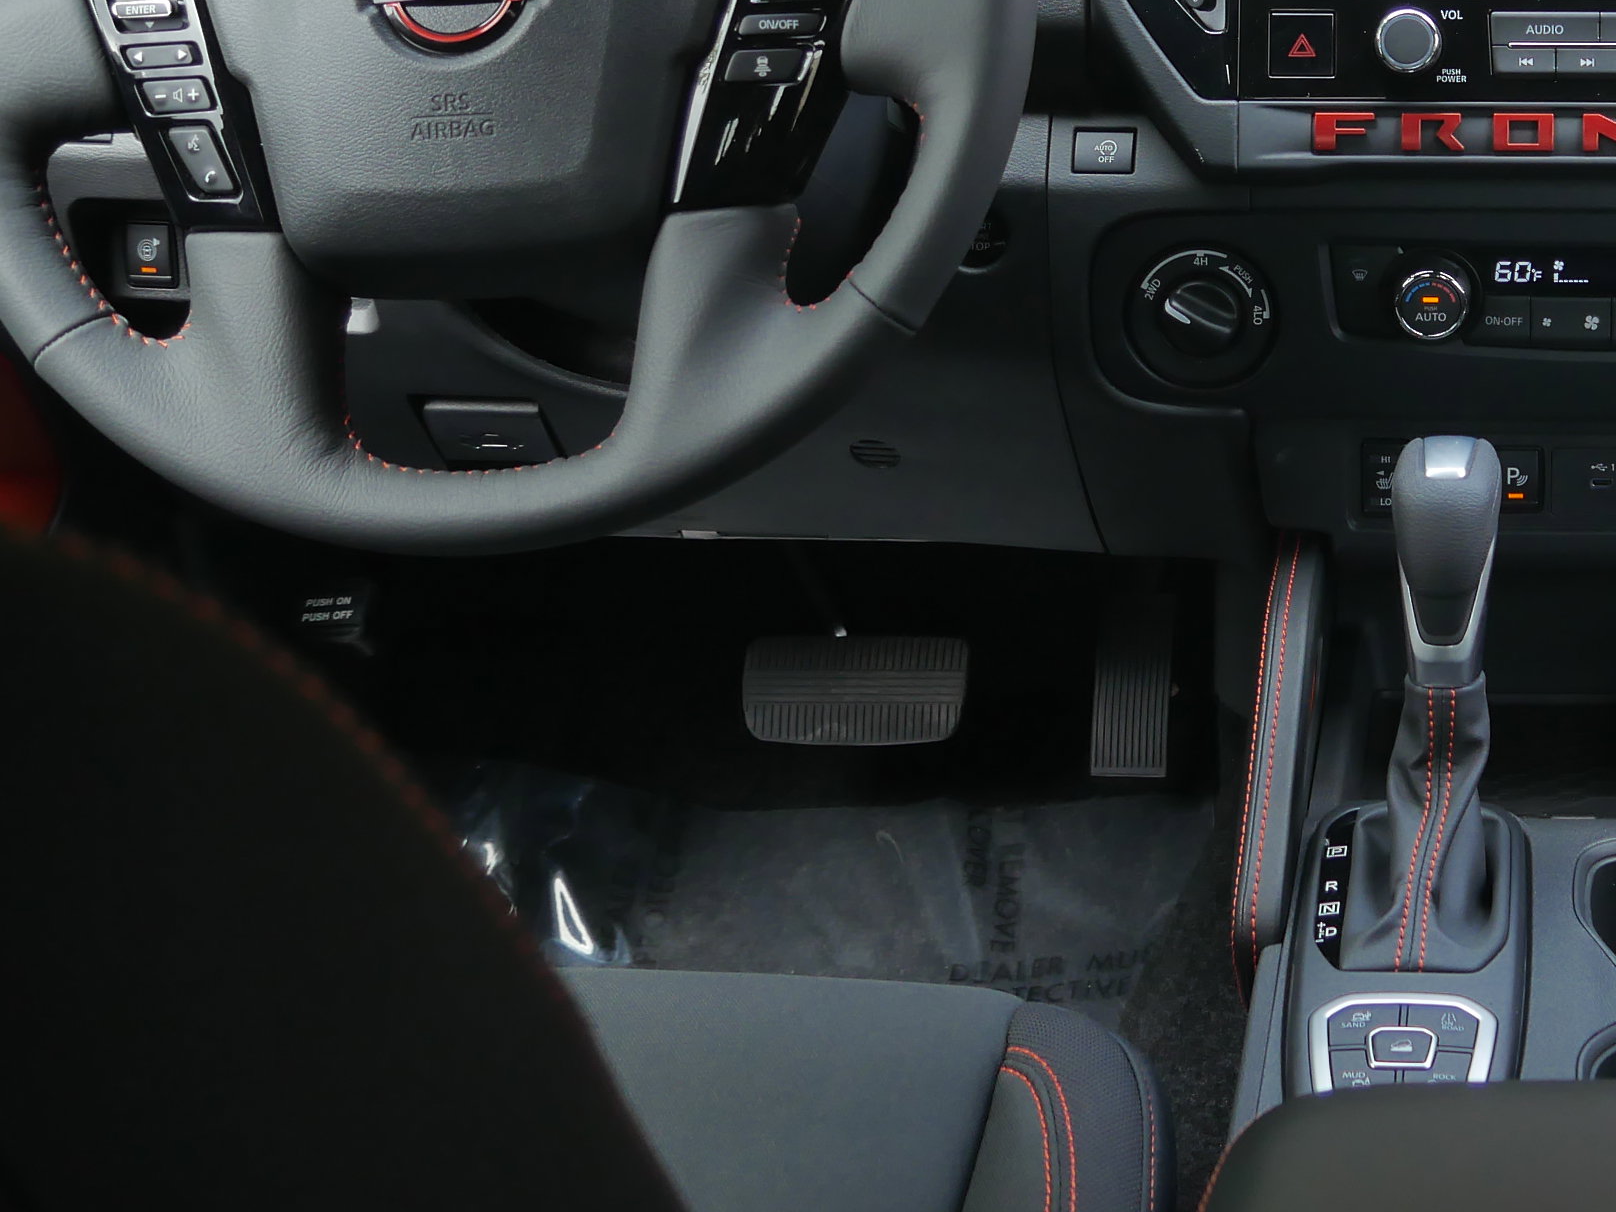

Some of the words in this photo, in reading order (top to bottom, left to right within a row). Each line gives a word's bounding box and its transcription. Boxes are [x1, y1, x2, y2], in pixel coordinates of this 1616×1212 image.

[125, 4, 156, 15] ENTER
[1441, 10, 1463, 20] VOL
[759, 20, 799, 29] ON/OFF
[1526, 24, 1564, 35] AUDIO
[1436, 75, 1467, 83] POWER
[431, 93, 470, 111] SRS
[411, 119, 495, 140] AIRBAG
[1194, 257, 1208, 266] 4H
[1233, 264, 1253, 284] PUSH
[1144, 278, 1161, 300] 2WD
[1253, 305, 1262, 325] 4LO
[1415, 313, 1447, 322] AUTO
[305, 598, 333, 607] PUSH
[336, 596, 352, 604] ON
[302, 612, 330, 622] PUSH
[332, 610, 354, 620] OFF
[1330, 847, 1344, 855] P
[1325, 881, 1338, 891] R
[1322, 904, 1336, 913] N
[1326, 927, 1337, 937] D
